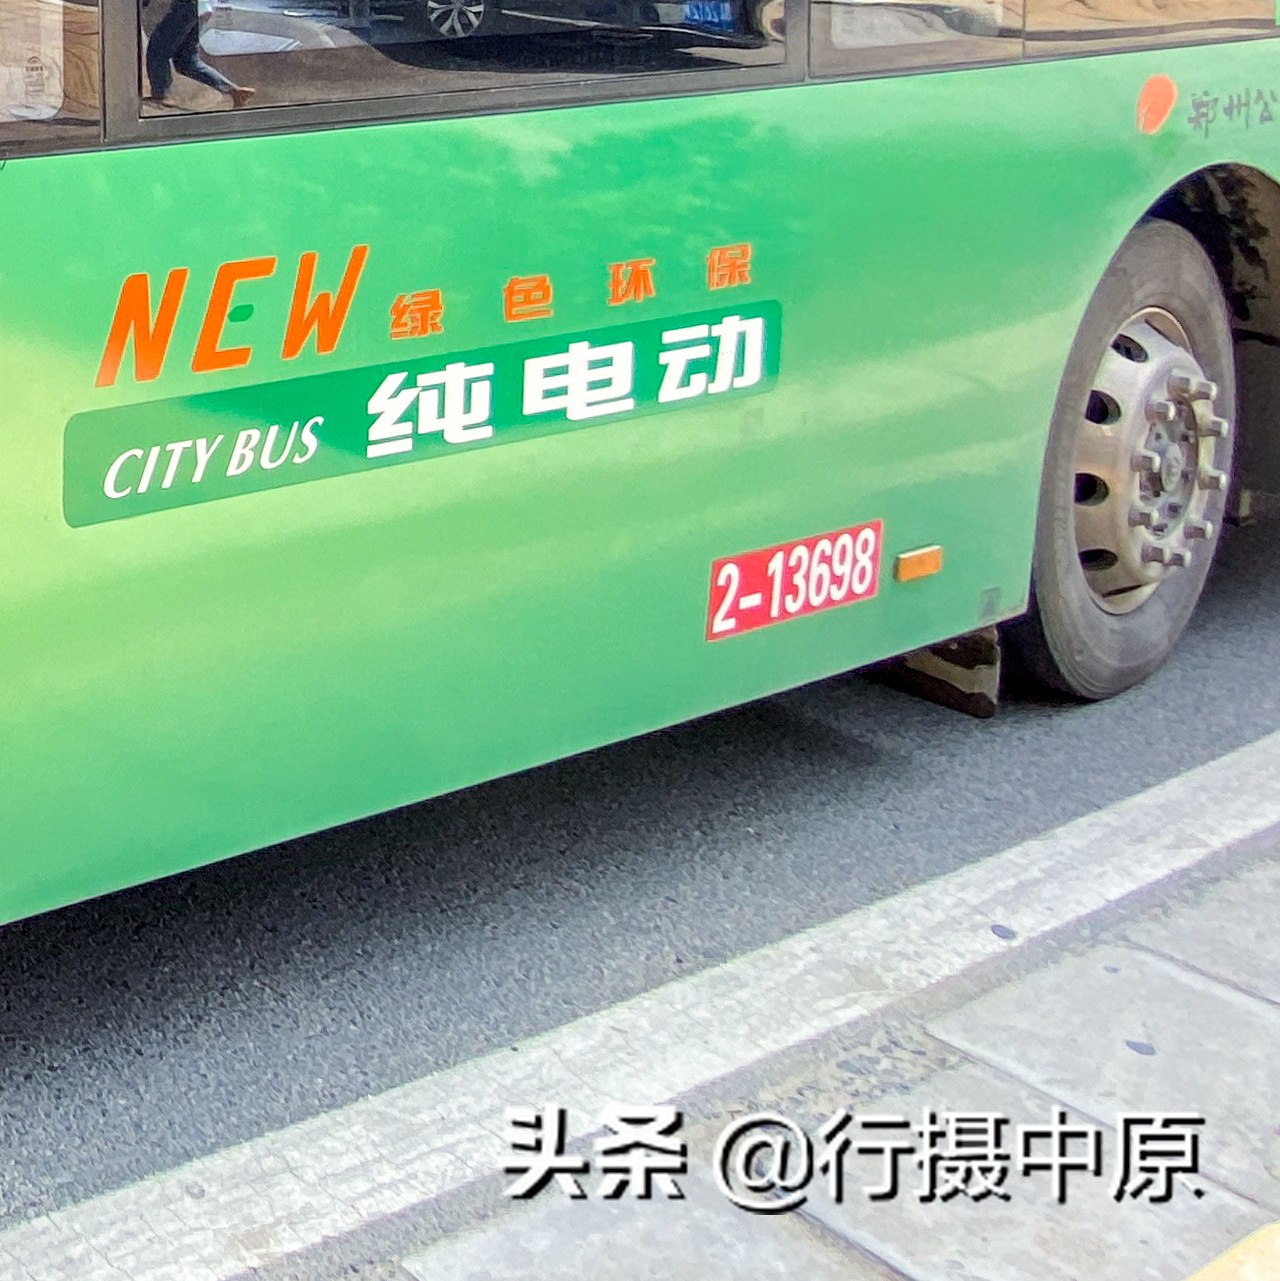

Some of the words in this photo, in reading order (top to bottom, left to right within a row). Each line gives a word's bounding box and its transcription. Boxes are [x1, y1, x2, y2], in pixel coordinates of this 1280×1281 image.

[95, 244, 370, 388] NEW
[388, 243, 754, 341] 绿色环保
[366, 314, 764, 458] 纯电动
[104, 436, 224, 500] CITY
[228, 416, 324, 476] BUS
[711, 533, 877, 635] 2-13698
